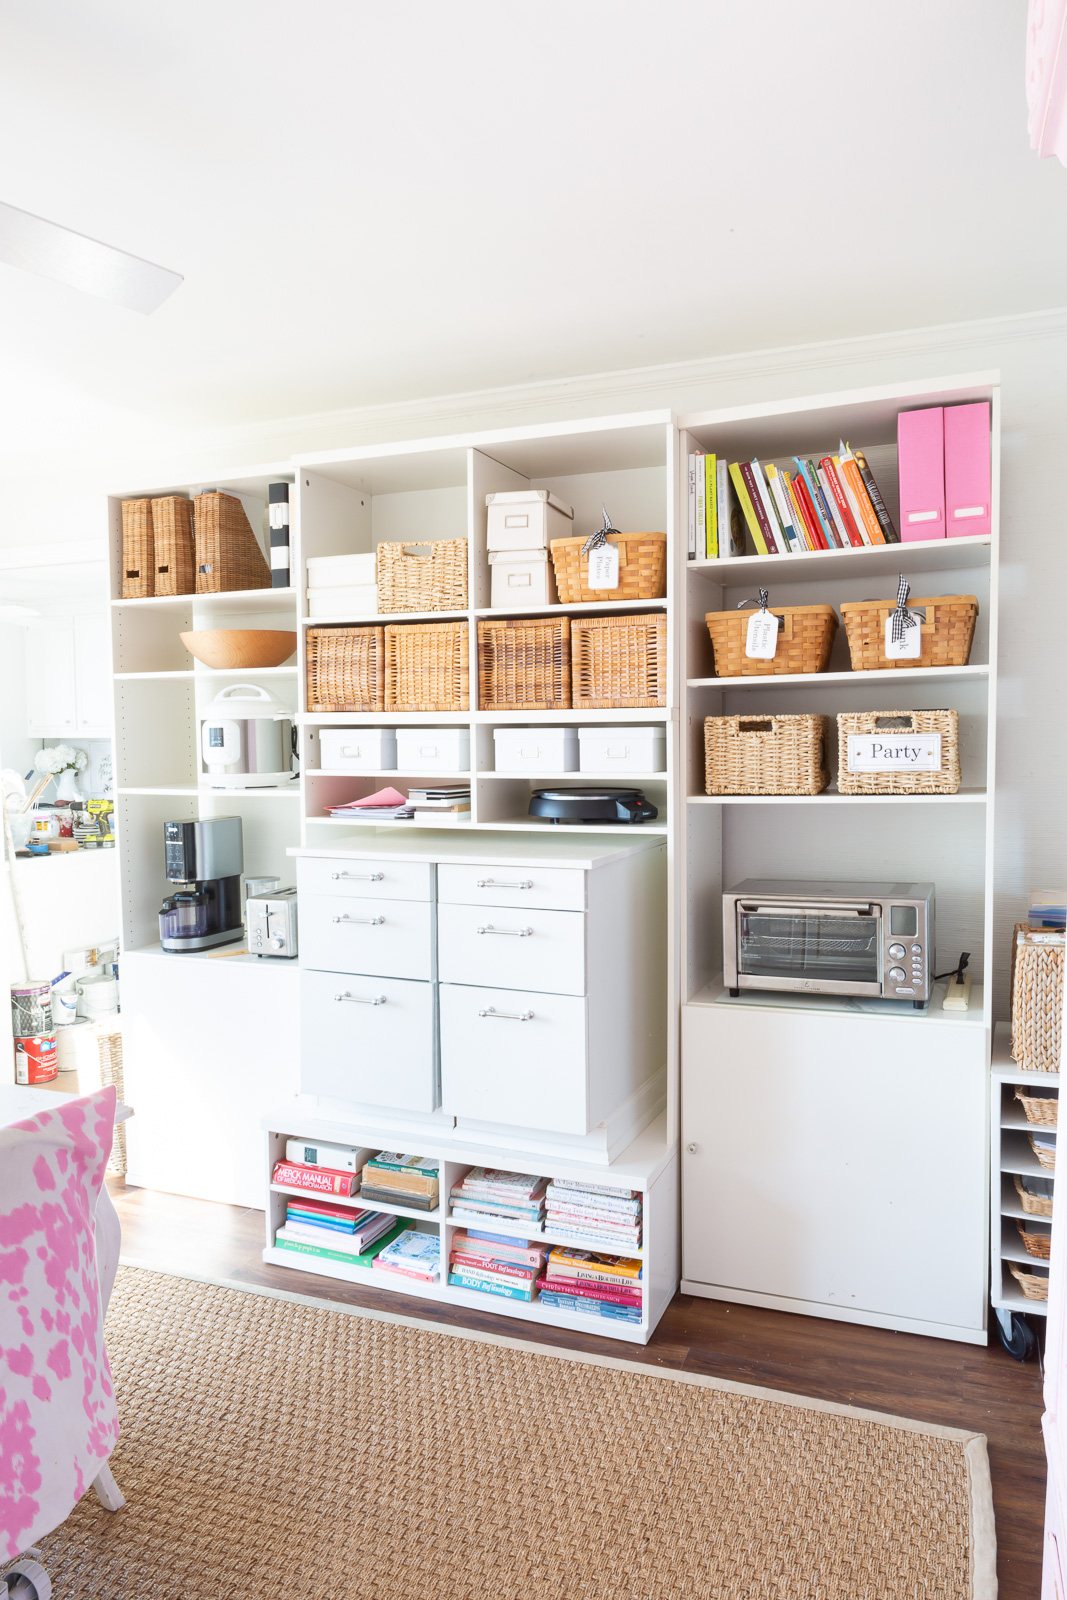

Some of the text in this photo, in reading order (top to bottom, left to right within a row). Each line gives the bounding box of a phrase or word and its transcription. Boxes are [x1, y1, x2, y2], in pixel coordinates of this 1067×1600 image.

[751, 620, 761, 652] Utensils
[761, 624, 771, 650] Plastic
[871, 743, 921, 762] Party
[277, 1168, 332, 1186] MERCK MANUAL
[284, 1177, 302, 1187] MEDICAL
[303, 1180, 332, 1191] INFORMATION
[482, 1261, 498, 1270] FOOT
[498, 1266, 526, 1277] Reflexology
[577, 1271, 594, 1279] LIVING
[462, 1277, 481, 1287] BODY
[481, 1282, 513, 1296] Reflexology
[541, 1283, 579, 1294] CHRISTMAS
